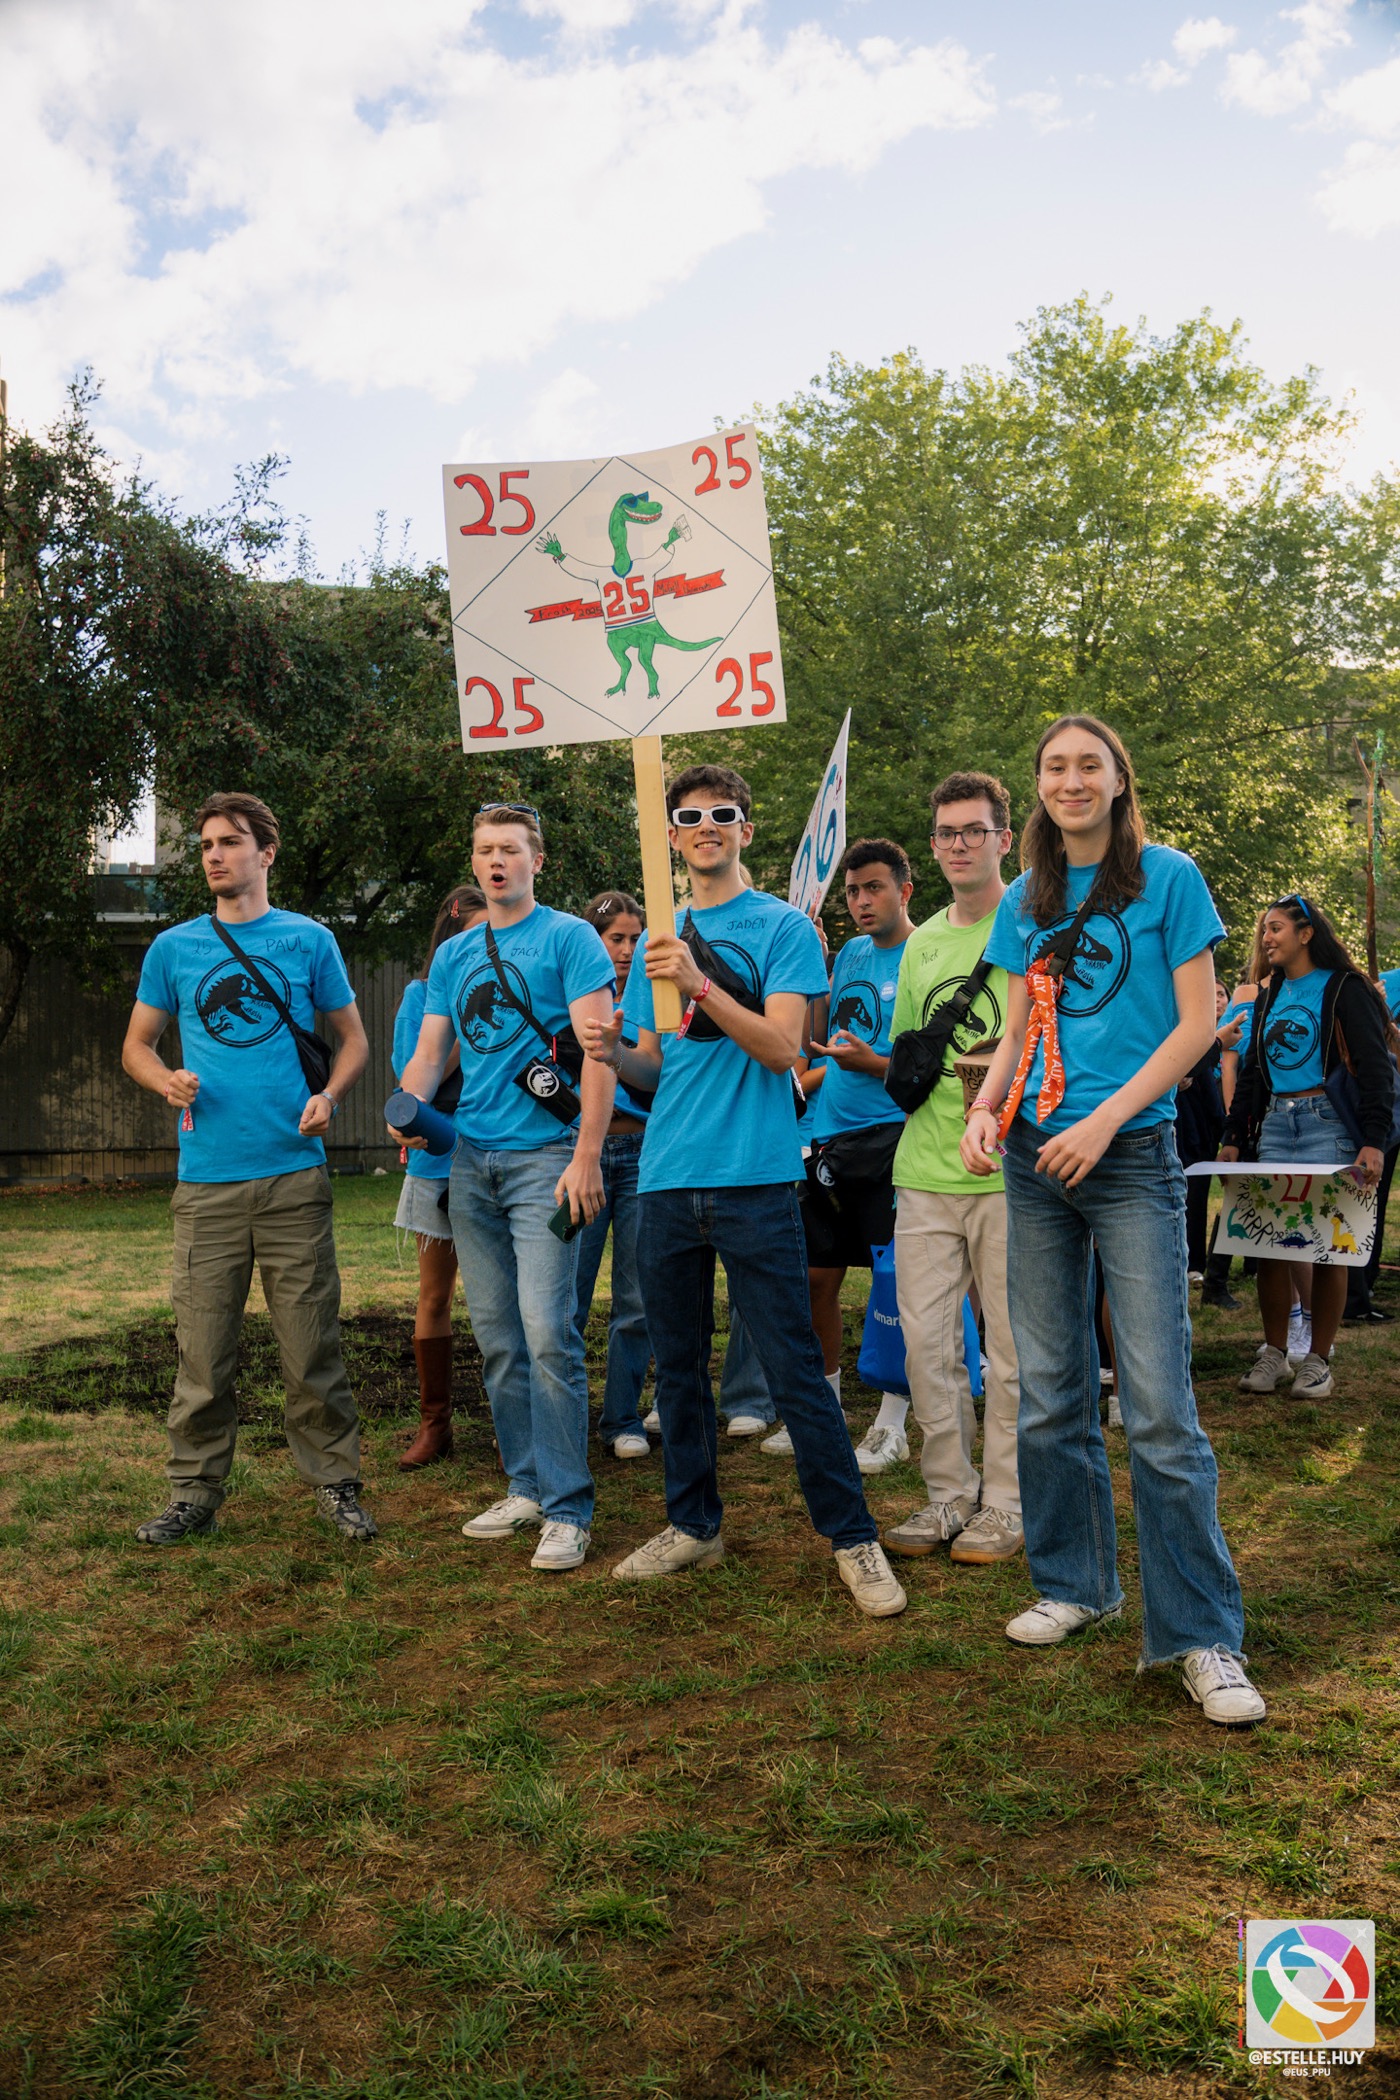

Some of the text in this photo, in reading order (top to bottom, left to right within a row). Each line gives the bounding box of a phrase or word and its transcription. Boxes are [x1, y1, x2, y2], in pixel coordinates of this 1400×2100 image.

[692, 433, 752, 496] 25
[453, 470, 536, 536] 25
[603, 575, 651, 618] 25
[715, 651, 776, 717] 25
[465, 676, 544, 738] 25
[727, 917, 767, 931] JADEN
[191, 939, 212, 955] 25
[265, 935, 310, 954] PAUL
[511, 947, 541, 958] JACK
[1273, 1174, 1313, 1202] 27
